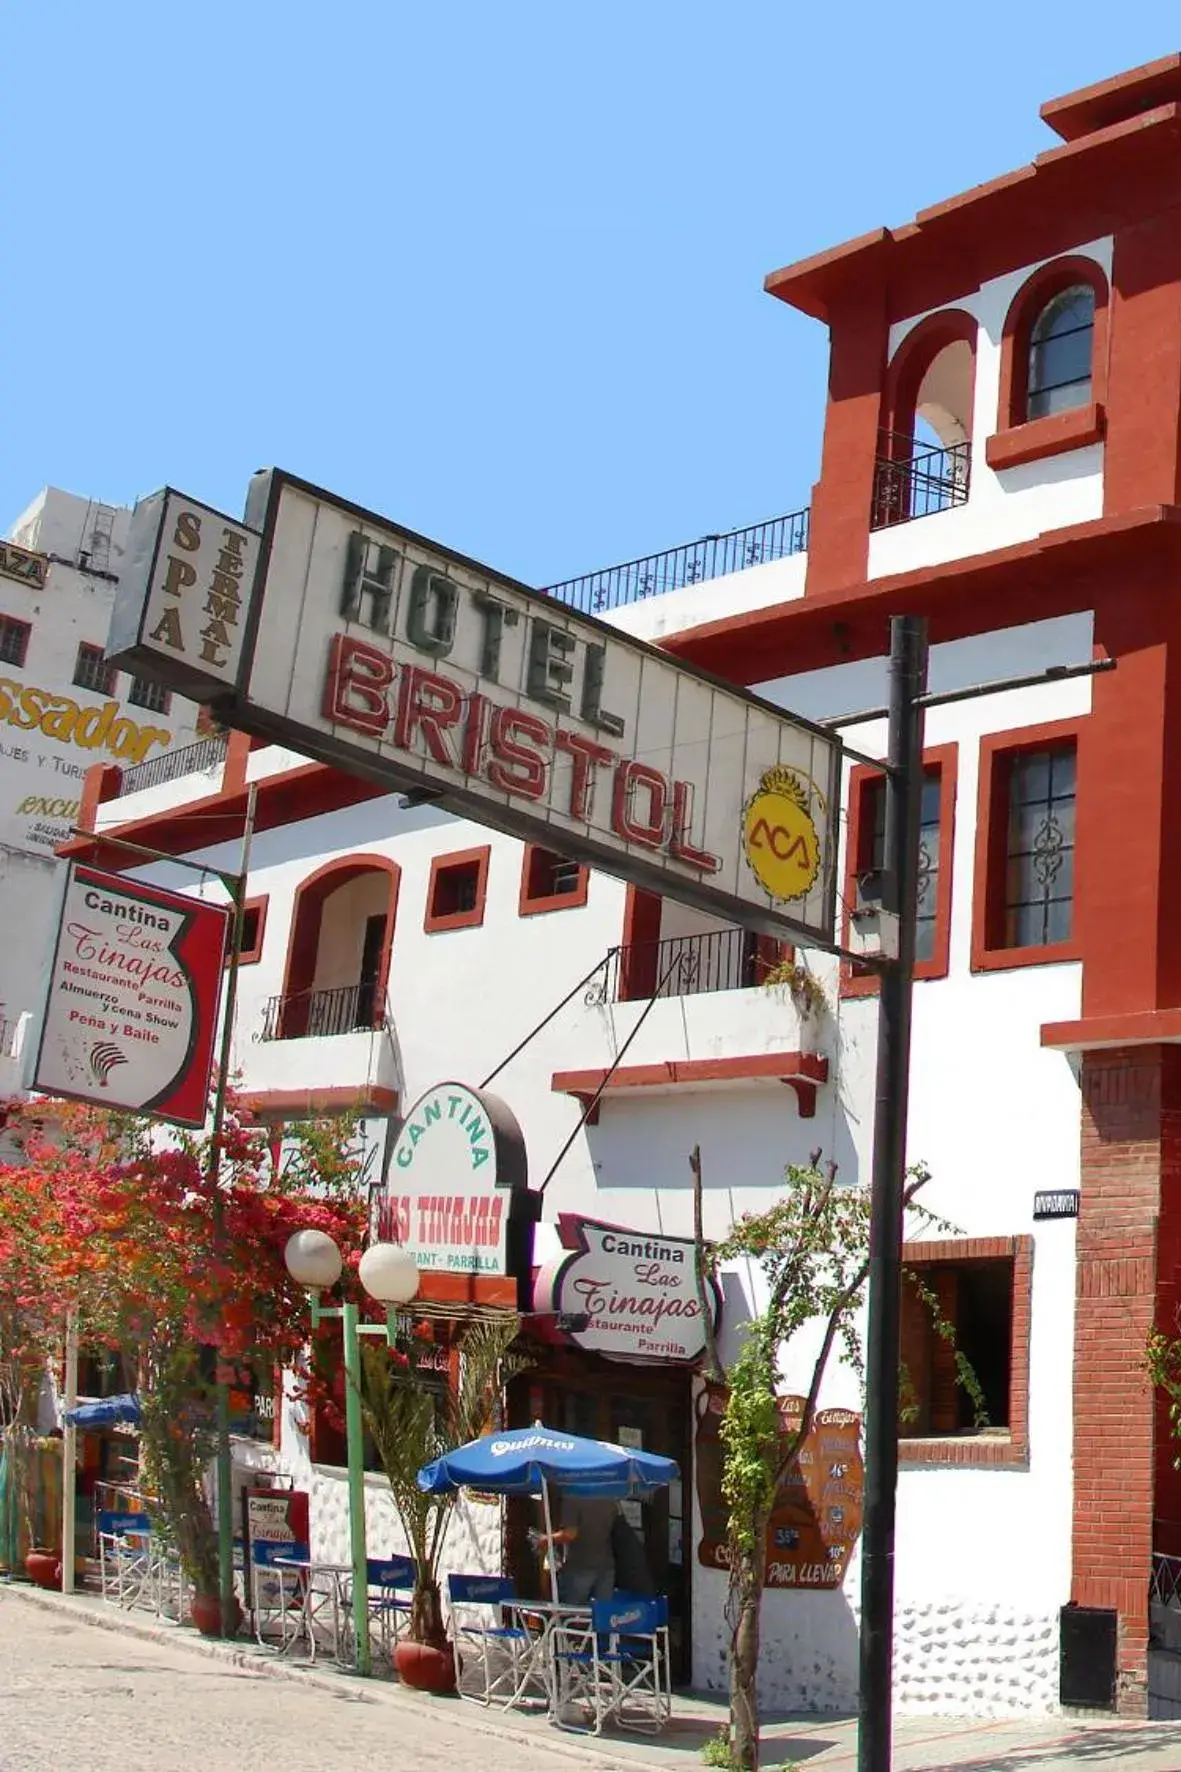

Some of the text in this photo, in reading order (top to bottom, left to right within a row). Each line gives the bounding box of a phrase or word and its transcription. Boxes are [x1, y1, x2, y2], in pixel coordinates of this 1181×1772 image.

[149, 511, 202, 653] SPA
[197, 527, 249, 668] TERMAL
[340, 531, 625, 740] HOTEL
[322, 633, 723, 874] BRISTOL
[84, 891, 170, 931] Cantina
[116, 924, 165, 952] Las
[67, 922, 188, 988] Tinajas
[63, 961, 139, 990] Restaurante
[60, 980, 119, 1003] Almuerzo
[138, 992, 183, 1012] Parrilla
[103, 1002, 179, 1029] y cena Show
[110, 1022, 119, 1034] y
[124, 1025, 160, 1044] Baile
[396, 1095, 490, 1170] CANTINA
[601, 1235, 684, 1263] Cantina
[633, 1263, 682, 1288] Las
[573, 1278, 701, 1327] Tinajas
[587, 1318, 654, 1334] staurante
[638, 1338, 686, 1354] Parrilla
